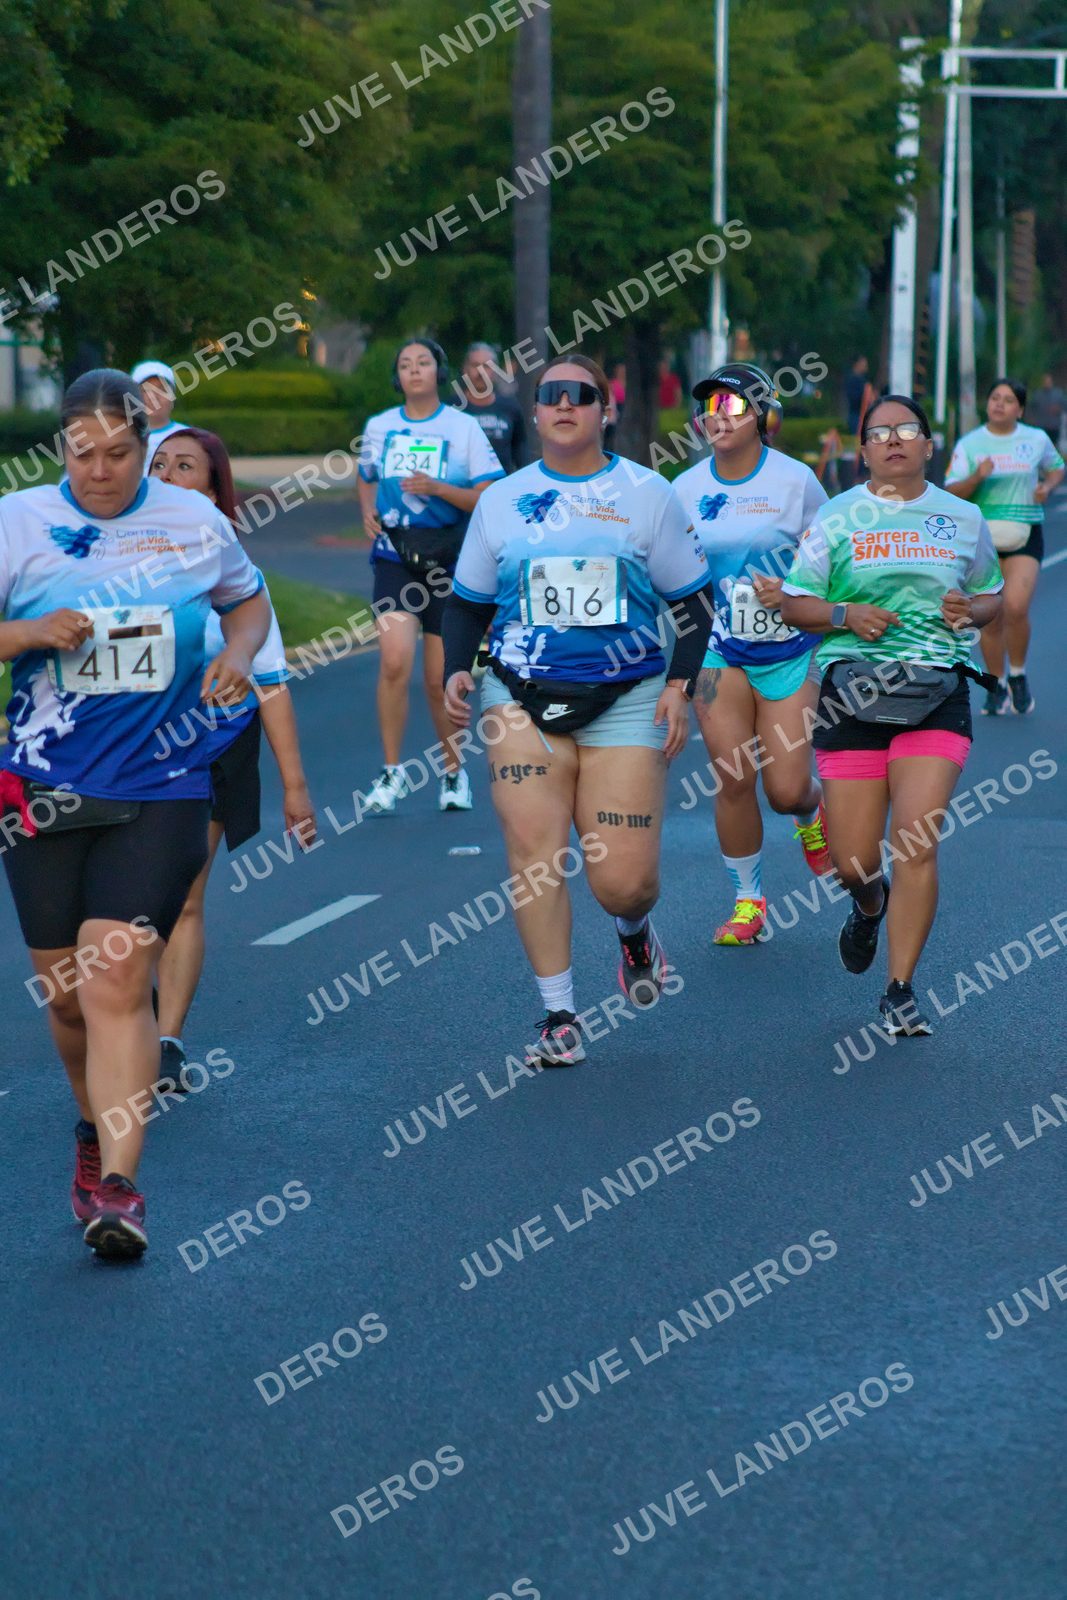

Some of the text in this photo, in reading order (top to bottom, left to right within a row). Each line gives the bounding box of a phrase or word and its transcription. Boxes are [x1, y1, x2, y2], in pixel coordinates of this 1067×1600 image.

[393, 453, 431, 471] 234
[595, 505, 615, 513] Vida
[147, 536, 170, 544] Vida
[852, 530, 920, 545] Carrera
[854, 543, 957, 561] SIN límites
[544, 586, 602, 617] 816
[738, 609, 796, 634] 189
[77, 642, 157, 681] 414
[549, 703, 569, 713] NIKE
[500, 764, 548, 784] eyes
